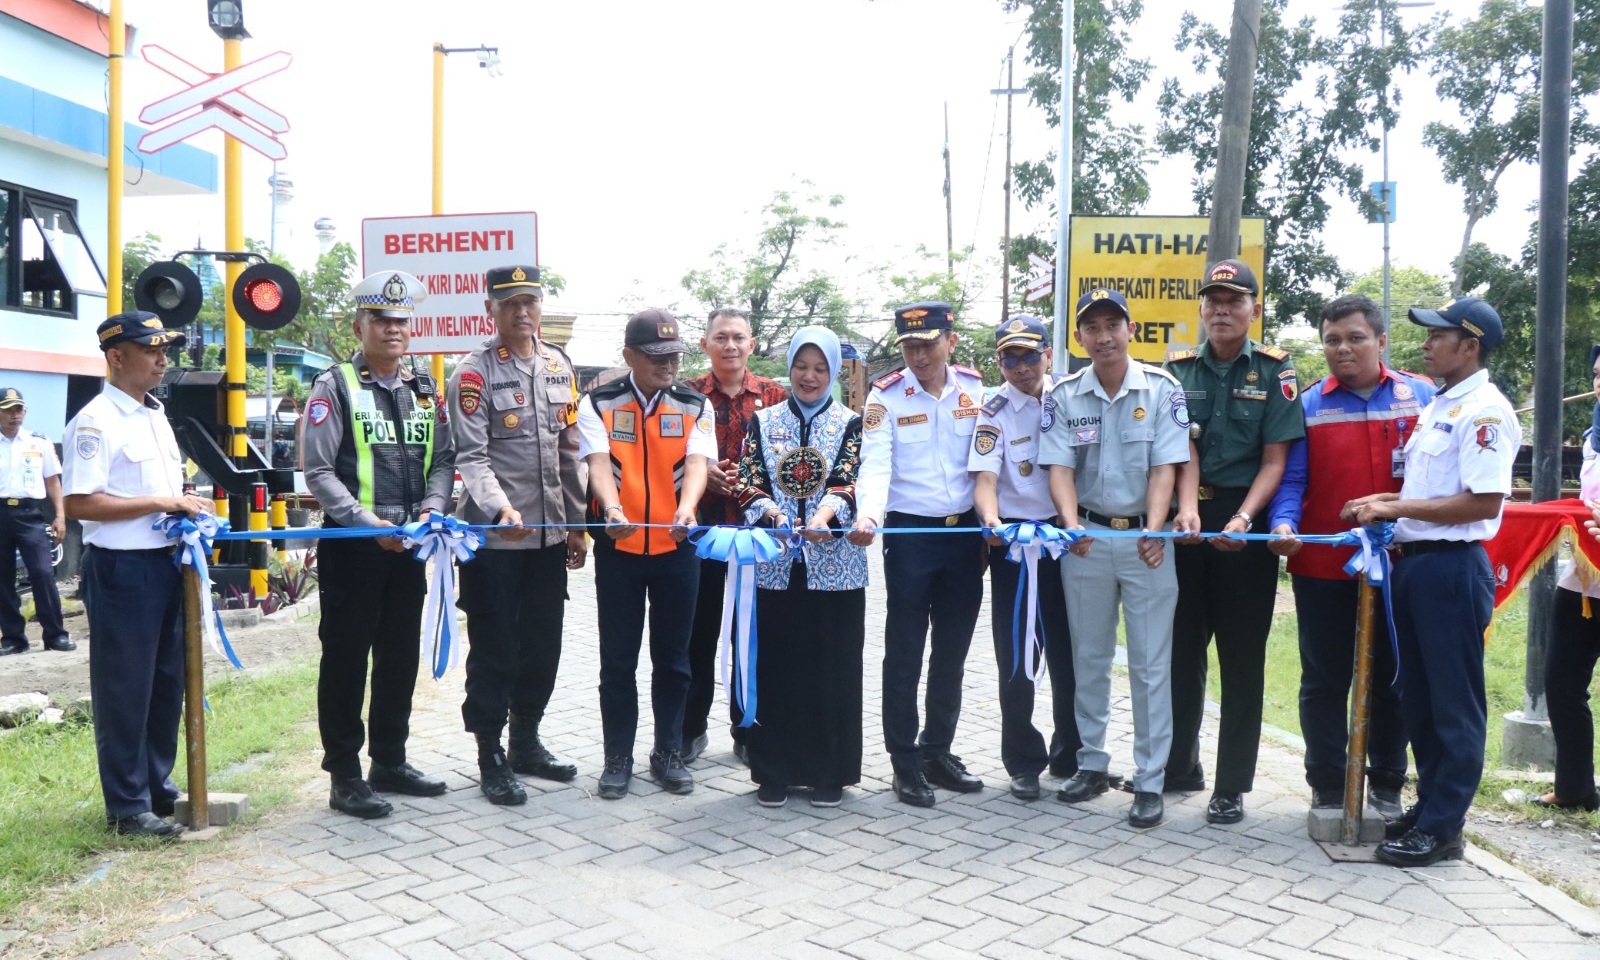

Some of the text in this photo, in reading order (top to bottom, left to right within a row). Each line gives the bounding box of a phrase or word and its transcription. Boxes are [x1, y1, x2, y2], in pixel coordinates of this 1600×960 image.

[384, 230, 514, 255] BERHENTI
[1094, 232, 1242, 255] HATI-HAI
[428, 274, 452, 295] KIRI
[455, 273, 479, 294] DAN
[545, 376, 569, 385] POLRI
[411, 411, 434, 420] POLRI
[1067, 416, 1102, 429] PUGUH
[362, 421, 430, 443] POLISI
[663, 420, 681, 430] KAI
